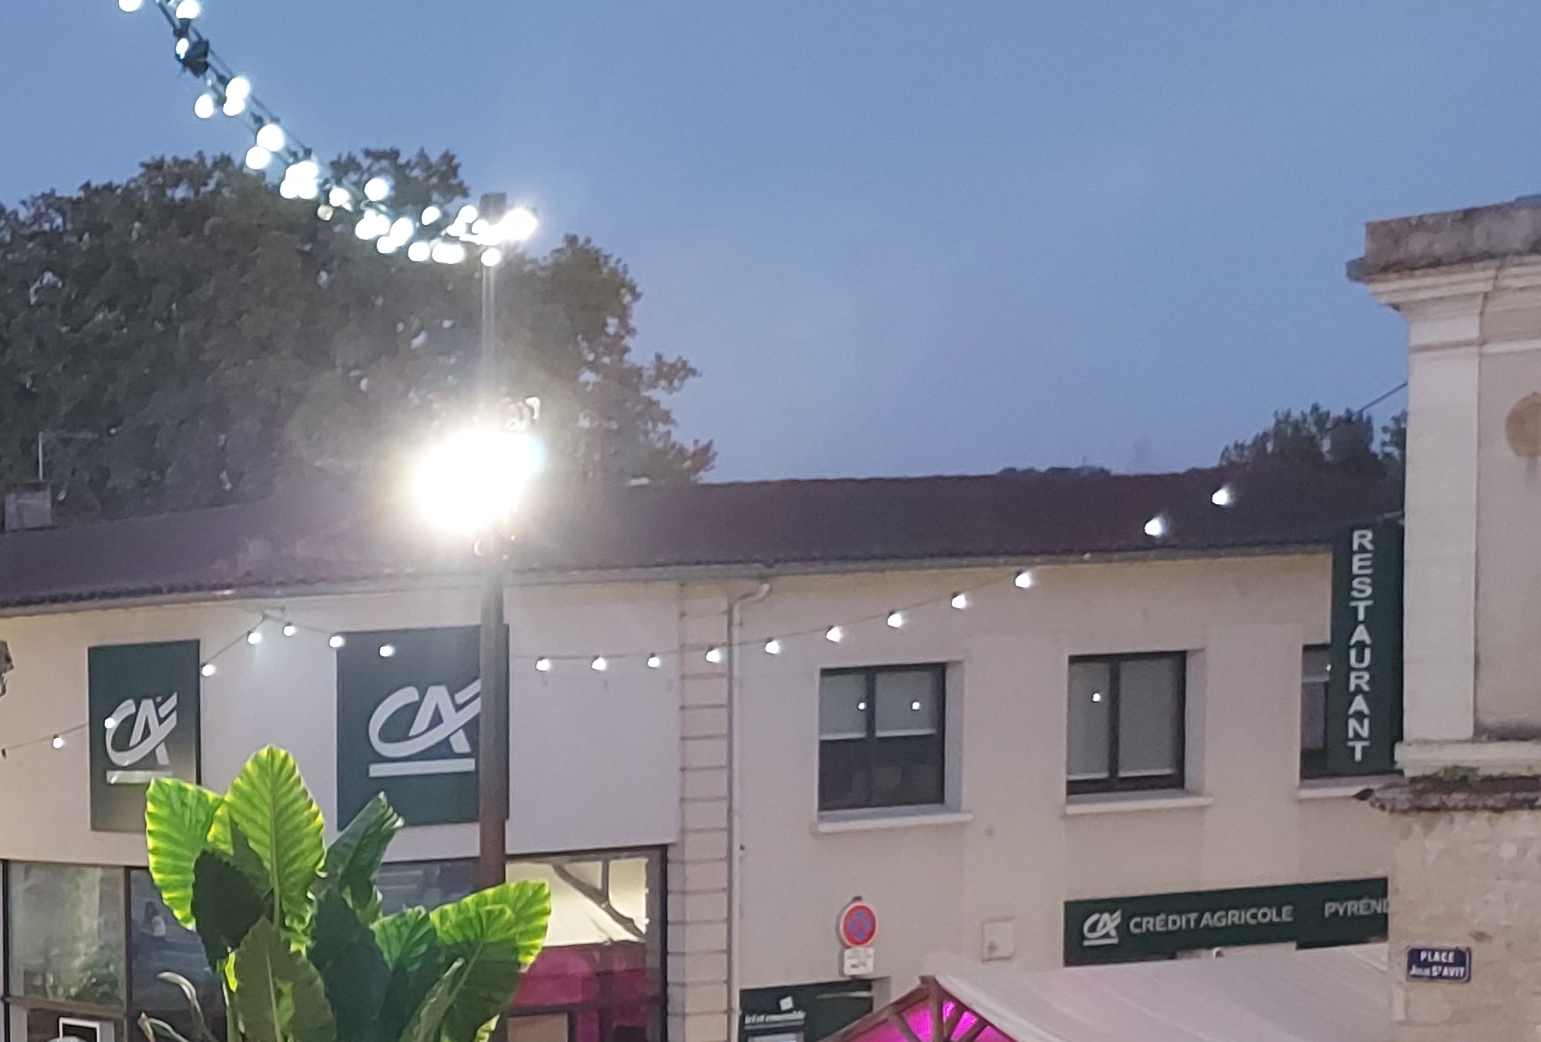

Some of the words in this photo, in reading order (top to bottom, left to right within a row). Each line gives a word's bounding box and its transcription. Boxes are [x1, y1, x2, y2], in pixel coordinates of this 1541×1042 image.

[1346, 529, 1375, 762] RESTAURANT
[1129, 911, 1198, 935] CRÉDIT
[1200, 905, 1294, 930] AGRICOLE
[1420, 951, 1455, 963] PLACE
